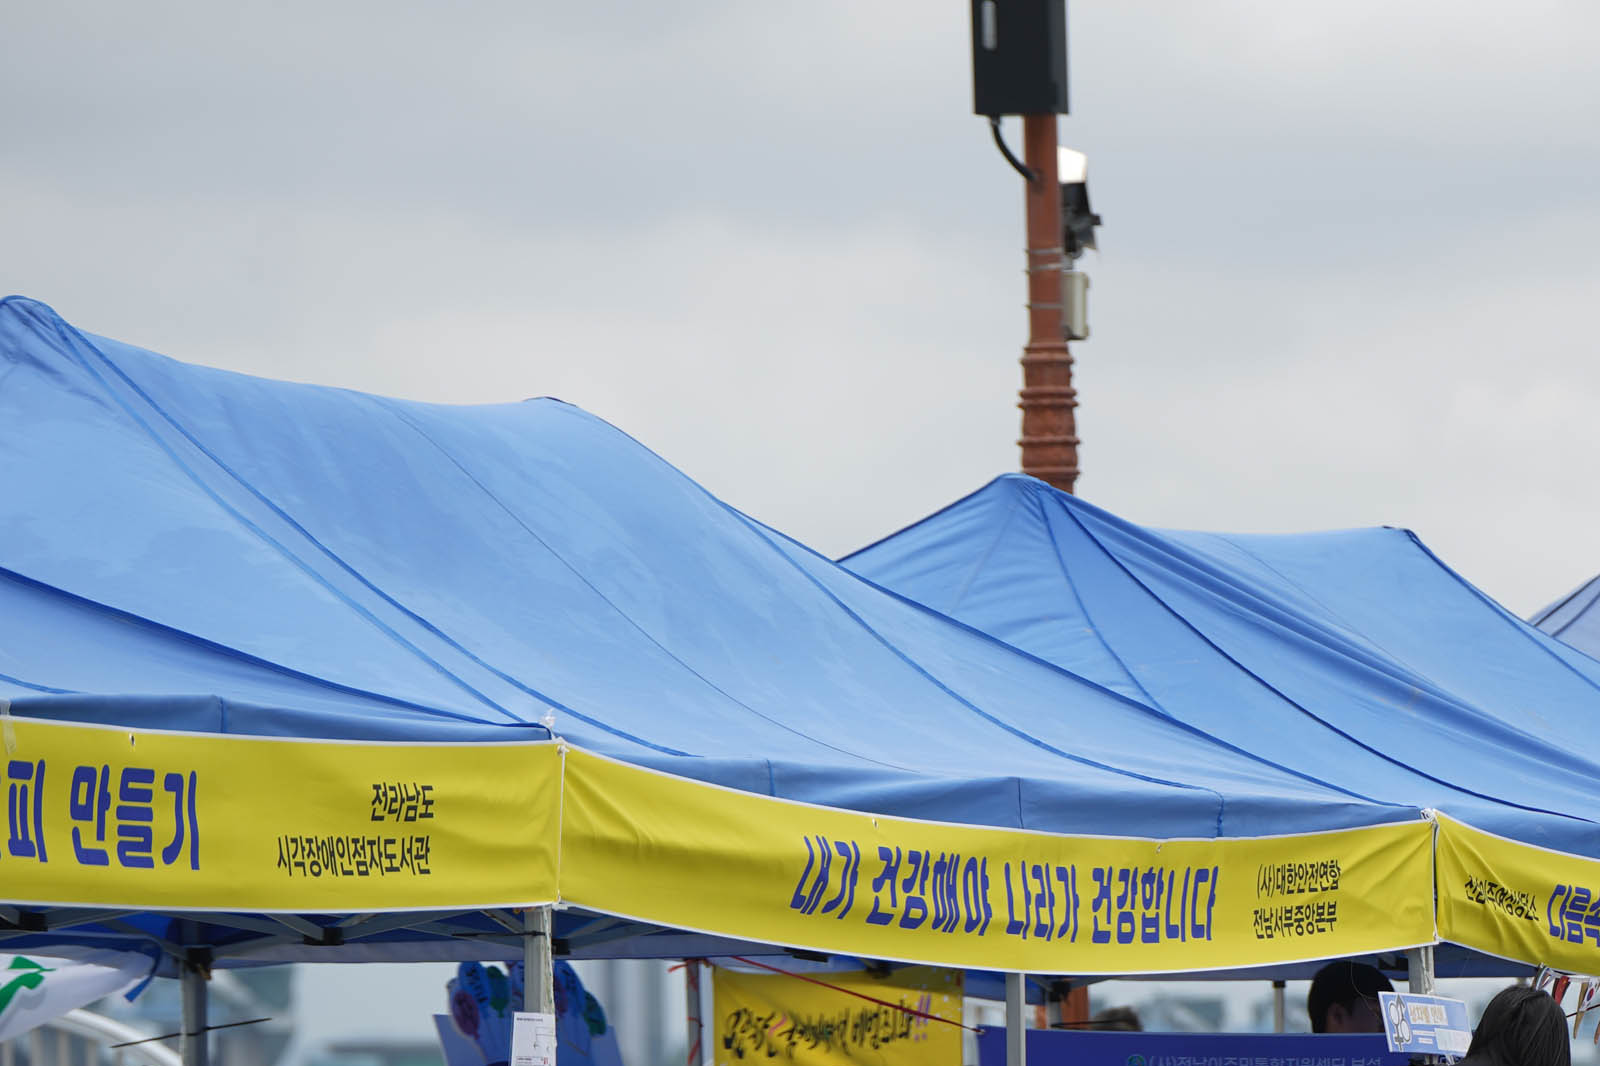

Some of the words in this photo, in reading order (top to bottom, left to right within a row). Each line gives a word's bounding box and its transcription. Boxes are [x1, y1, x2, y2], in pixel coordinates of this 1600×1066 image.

[0, 758, 48, 863] 피
[70, 763, 200, 871] 만들기
[370, 782, 434, 822] 전라남도
[277, 835, 431, 877] 시각장애인점자도서관
[789, 834, 860, 920] 내가
[866, 846, 992, 937] 건강해야
[1004, 858, 1079, 943] 나라가
[1092, 865, 1219, 944] 건강합니다
[1257, 859, 1341, 898] (사)대한안전연합
[1253, 900, 1337, 940] 전남서부중앙본부
